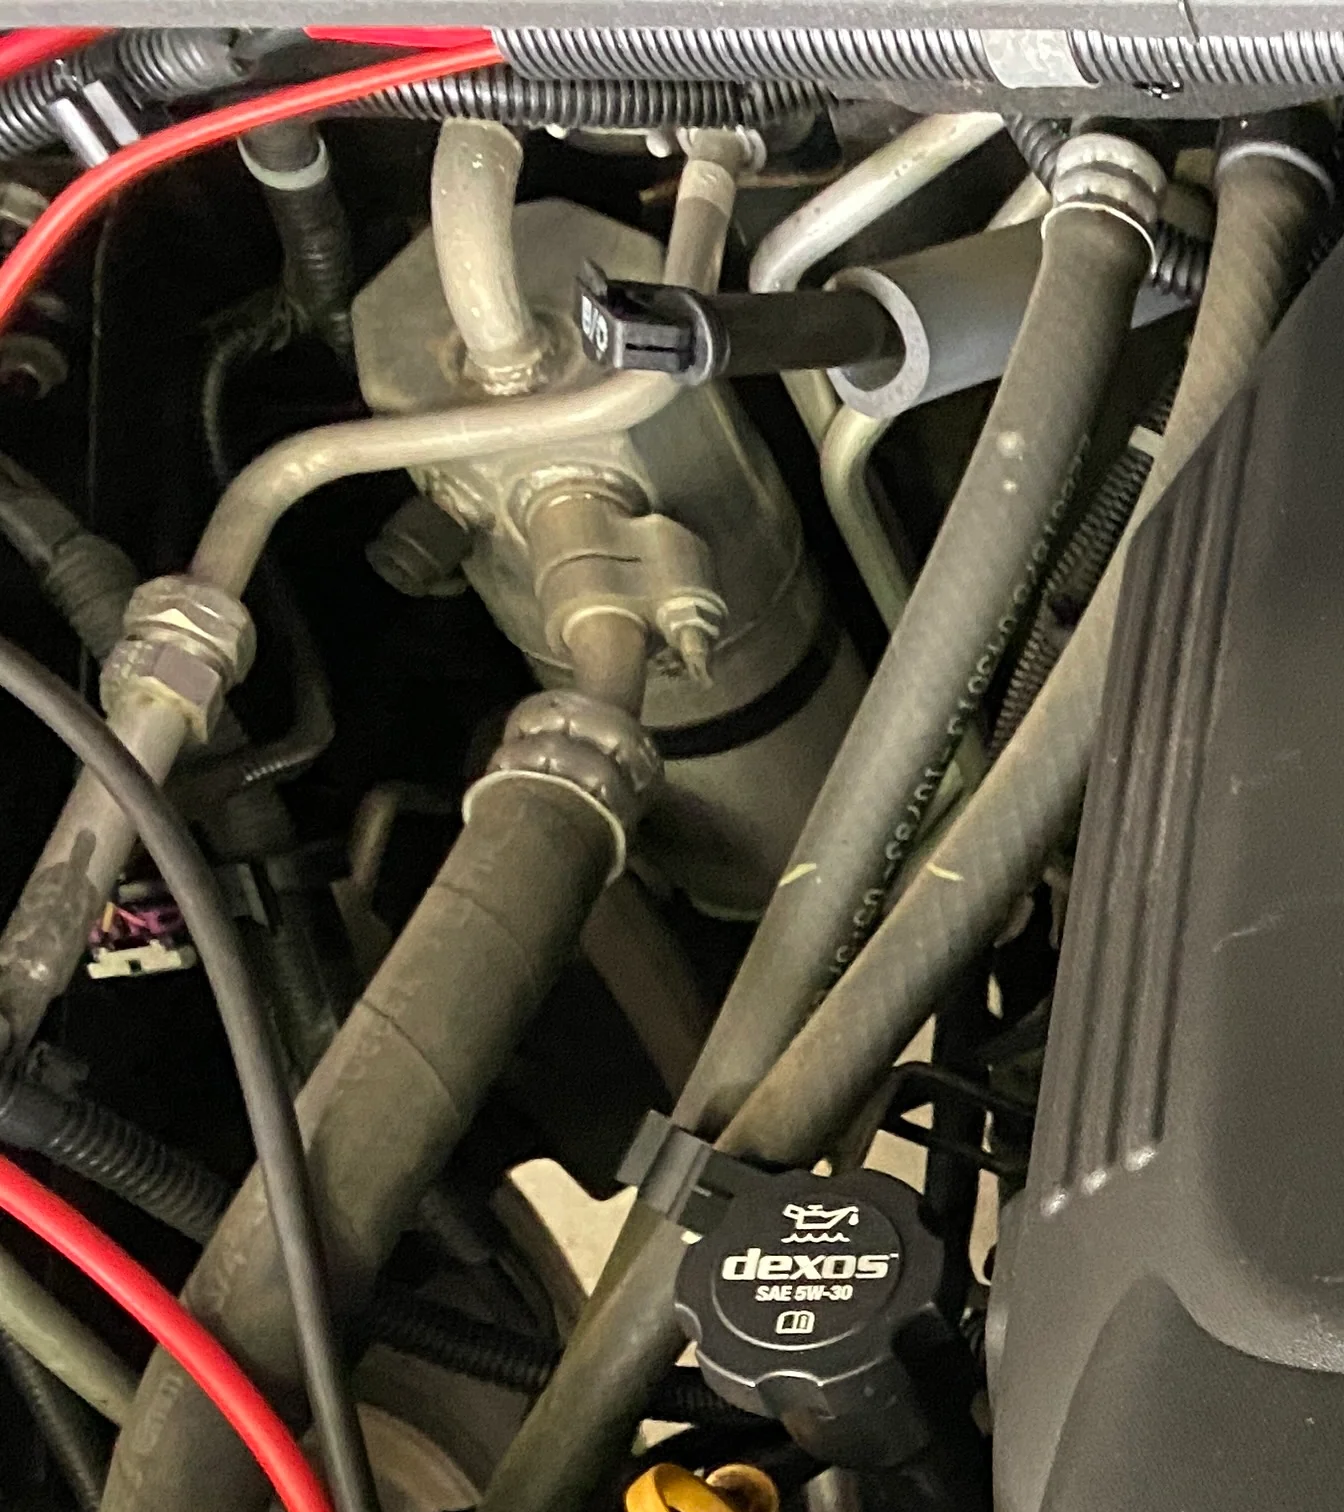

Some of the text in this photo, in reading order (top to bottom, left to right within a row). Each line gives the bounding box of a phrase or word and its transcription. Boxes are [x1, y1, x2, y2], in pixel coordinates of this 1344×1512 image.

[722, 1248, 890, 1280] dexos
[755, 1285, 853, 1301] SAE 5W-30
